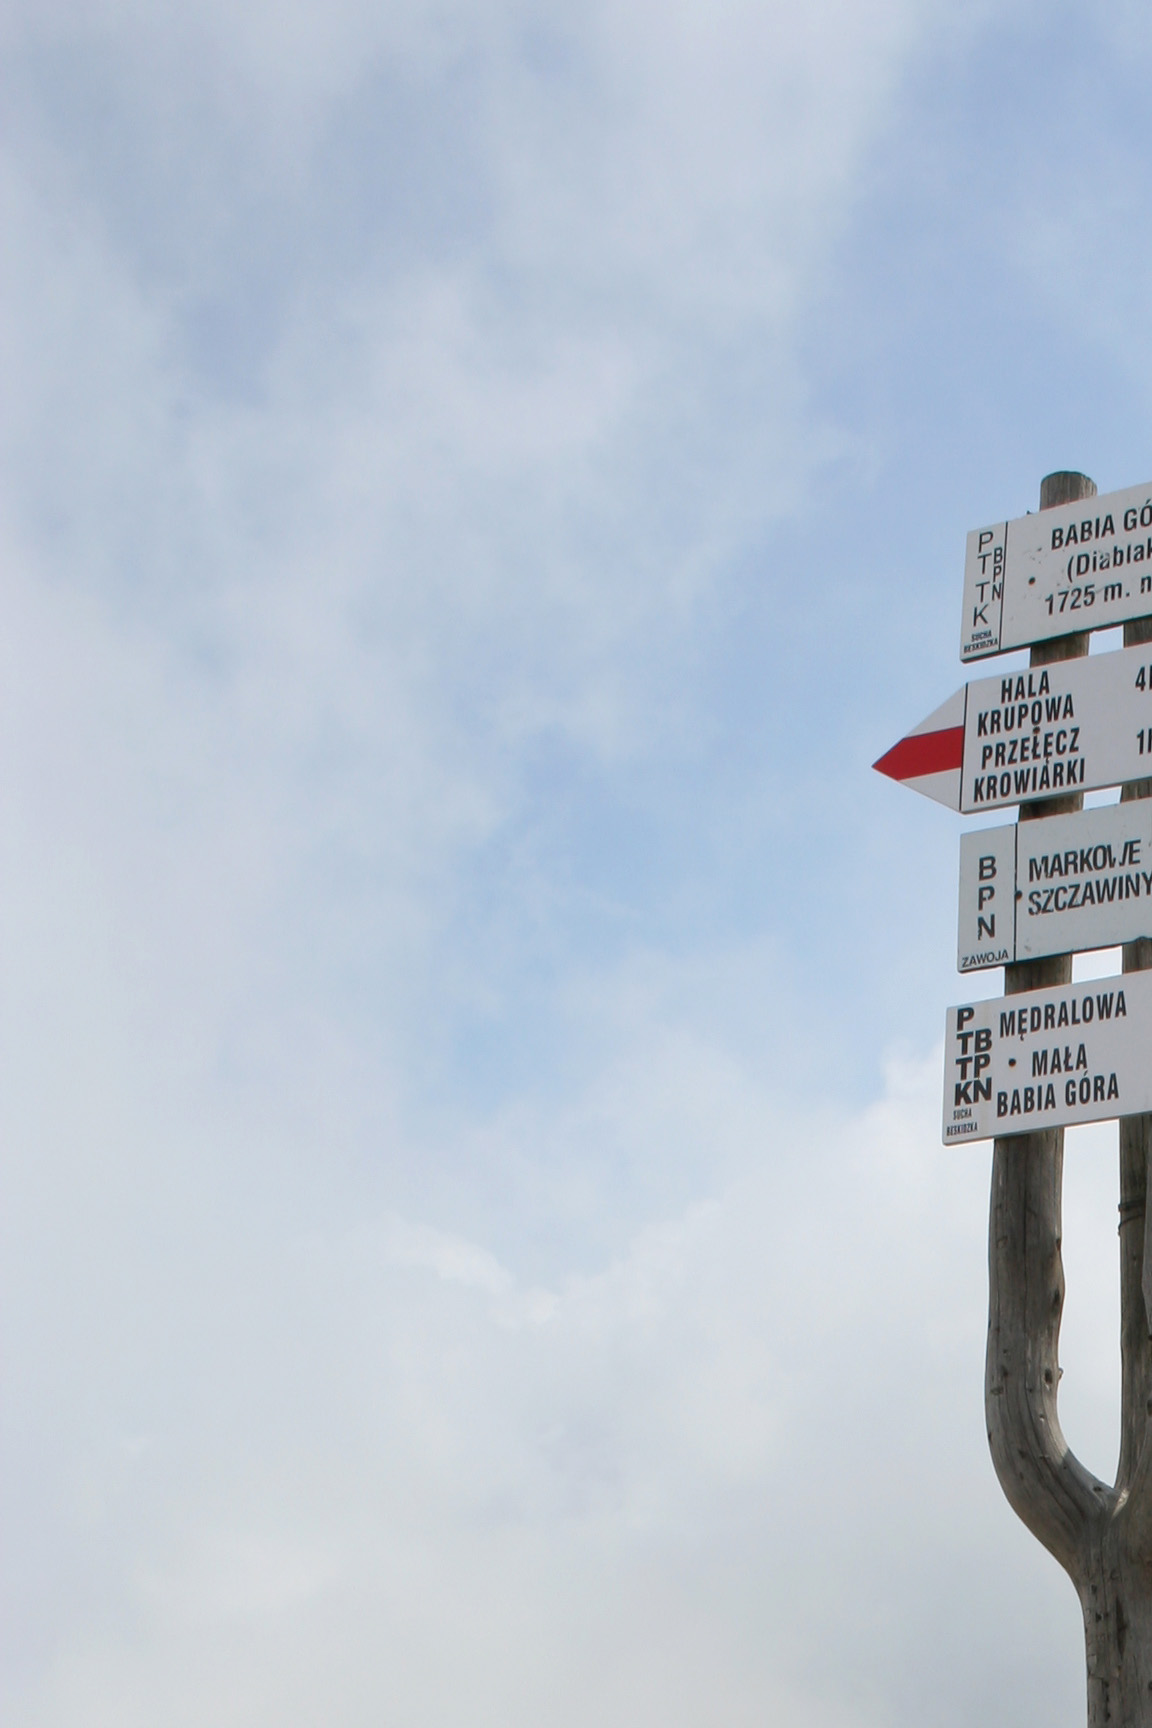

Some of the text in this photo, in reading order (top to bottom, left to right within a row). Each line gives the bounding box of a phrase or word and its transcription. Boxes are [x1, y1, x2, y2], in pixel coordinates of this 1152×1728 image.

[1051, 514, 1115, 550] BABIA
[1045, 584, 1095, 616] 1725
[1103, 582, 1130, 602] m.
[971, 630, 992, 642] SUCHA
[1001, 670, 1050, 704] HALA
[977, 694, 1074, 737] KRUPOWA
[981, 727, 1080, 770] PRZEŁĘCZ
[973, 758, 1086, 803] KROWIARKI
[961, 949, 1009, 968] ZAWOJA
[999, 990, 1127, 1041] MĘDRALOWA
[1031, 1043, 1088, 1078] MAŁA
[997, 1070, 1120, 1118] BABIA GÓRA
[953, 1108, 972, 1121] SUCHA
